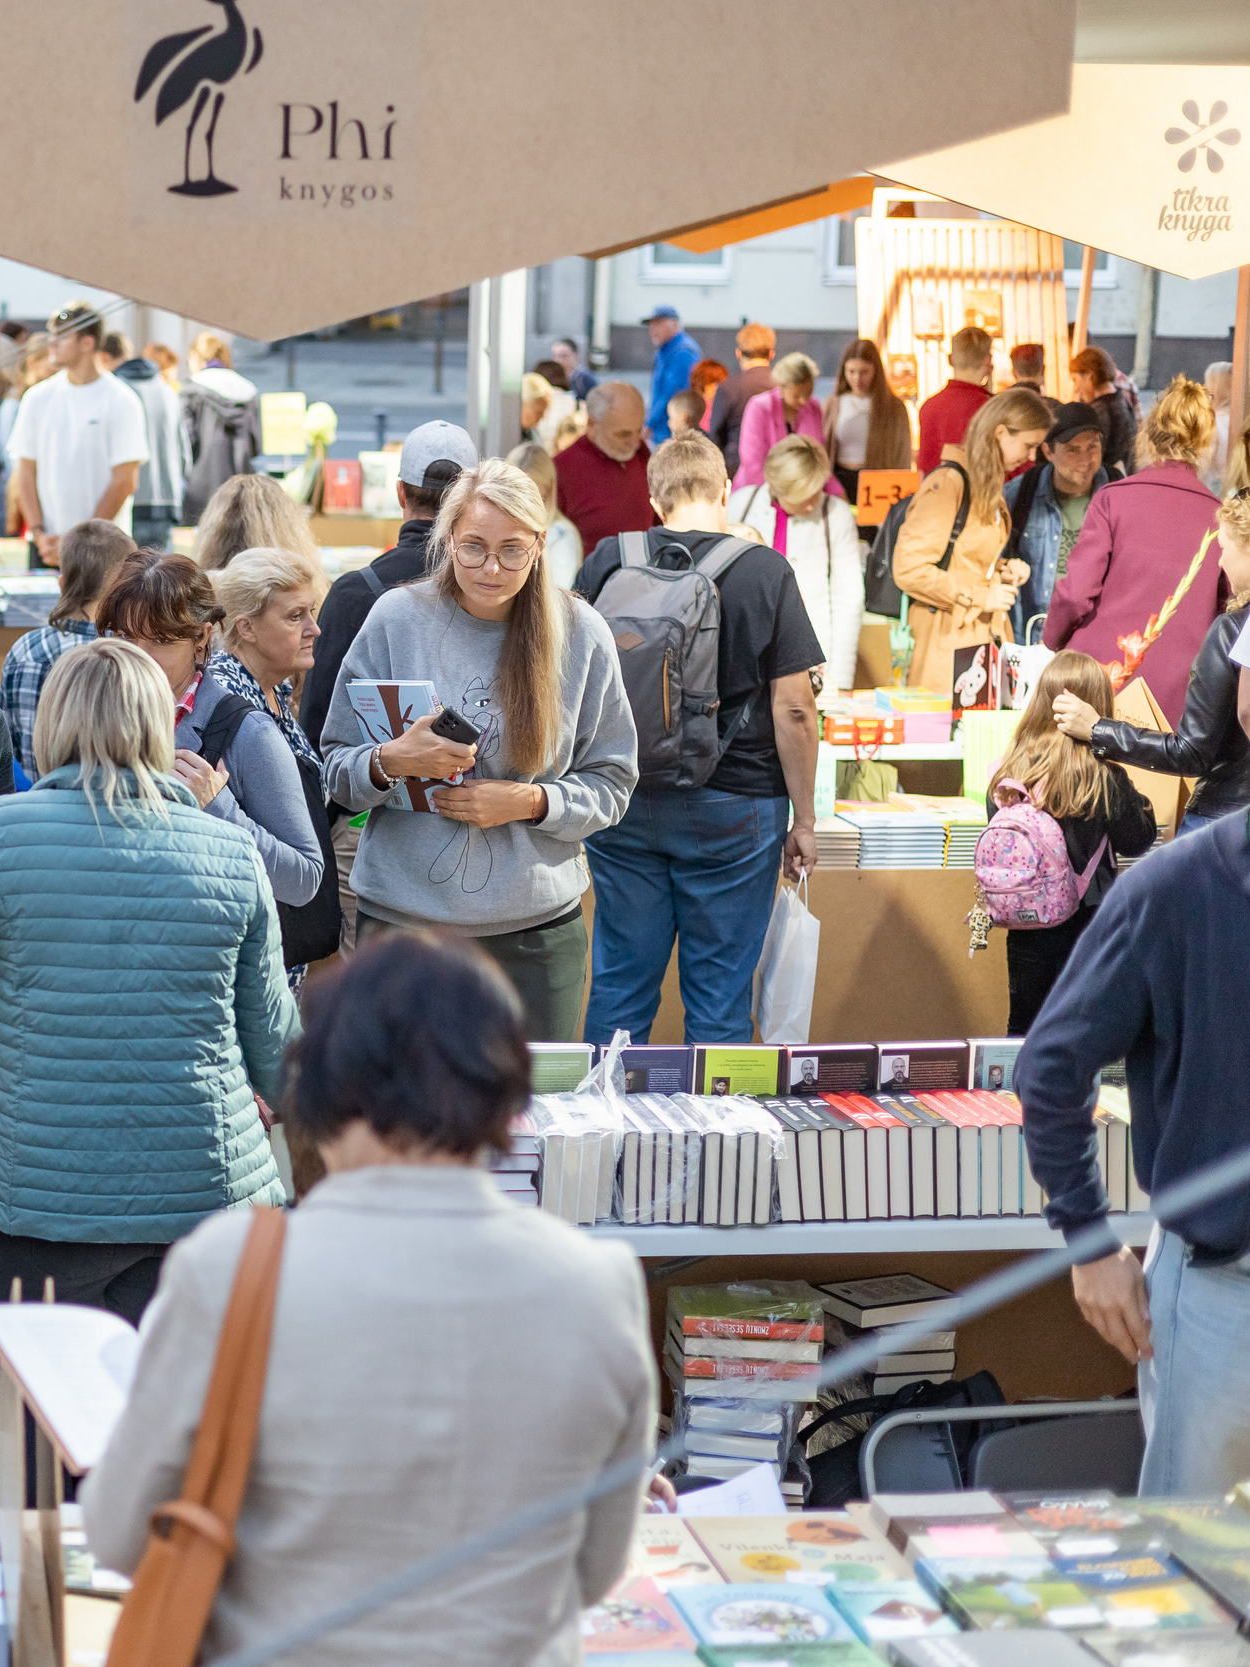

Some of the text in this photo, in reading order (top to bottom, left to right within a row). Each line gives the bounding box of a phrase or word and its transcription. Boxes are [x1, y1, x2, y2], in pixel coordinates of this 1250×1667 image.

[278, 100, 398, 160] Phi
[279, 176, 395, 208] knygos
[1173, 185, 1230, 212] tikra
[1158, 204, 1232, 242] knyga
